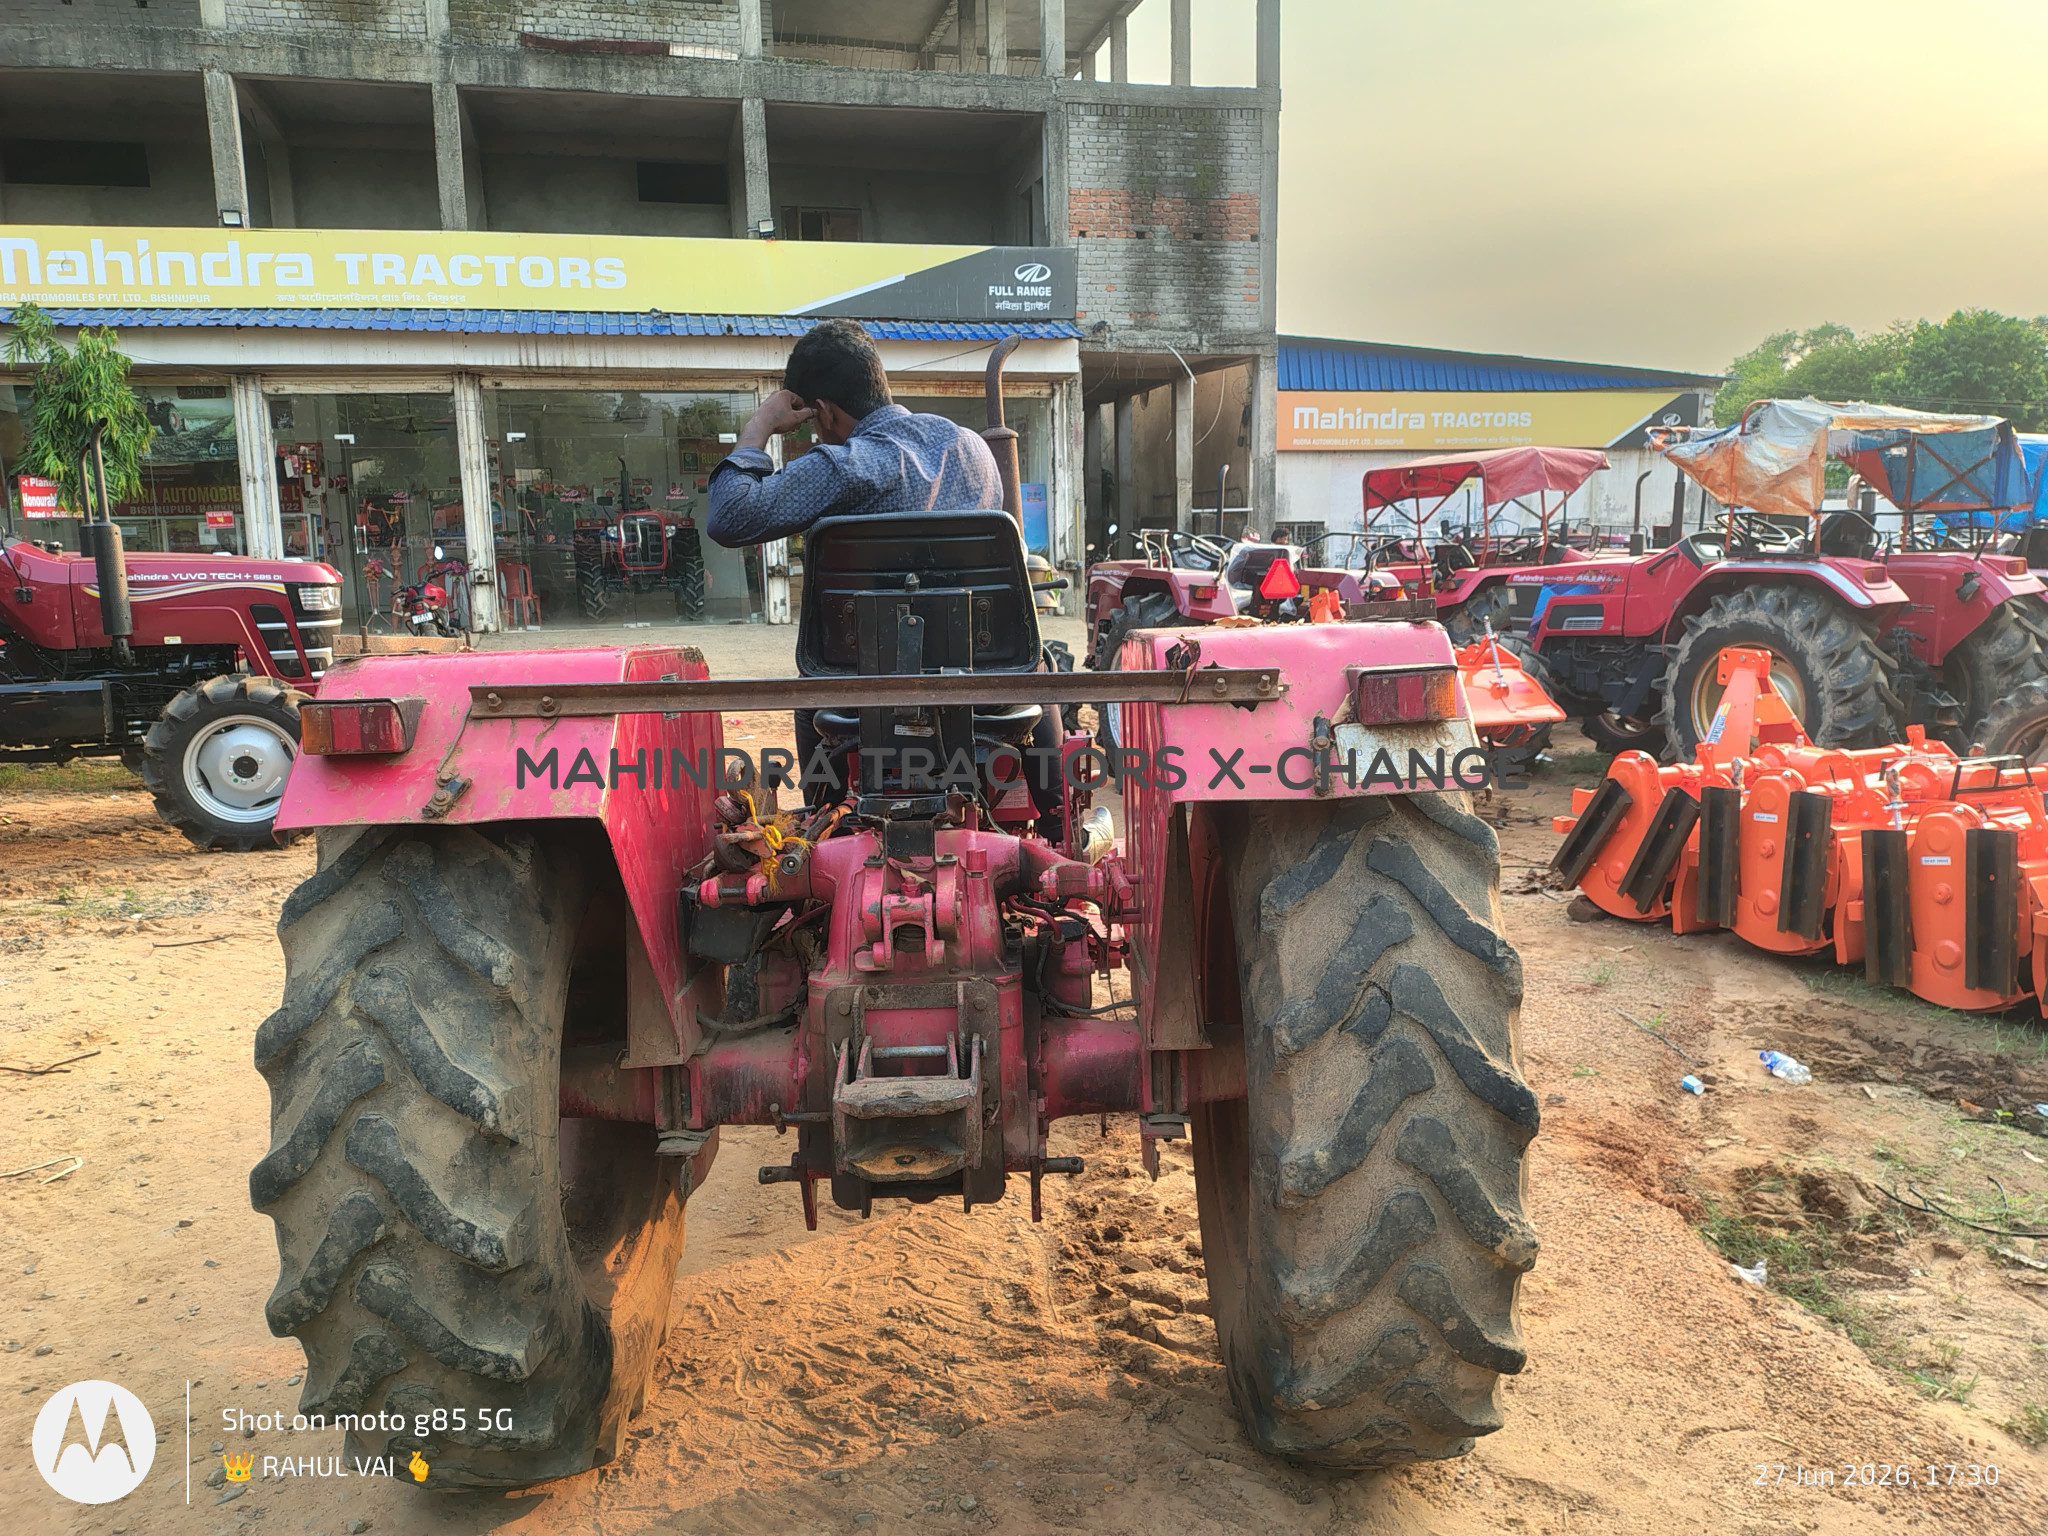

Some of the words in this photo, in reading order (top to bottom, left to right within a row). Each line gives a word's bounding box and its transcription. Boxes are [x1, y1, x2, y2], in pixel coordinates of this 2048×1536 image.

[335, 253, 627, 288] TRACTORS
[19, 293, 95, 302] AUTOMOBILES
[98, 293, 120, 302] PVT.
[150, 293, 211, 303] BISHNUPUR
[988, 286, 1014, 296] FULL
[1016, 286, 1052, 297] RANGE
[1293, 407, 1425, 430] Mahindra
[1431, 411, 1532, 428] TRACTORS
[162, 485, 242, 503] AUTOMOBILE
[127, 573, 168, 581] ahindra
